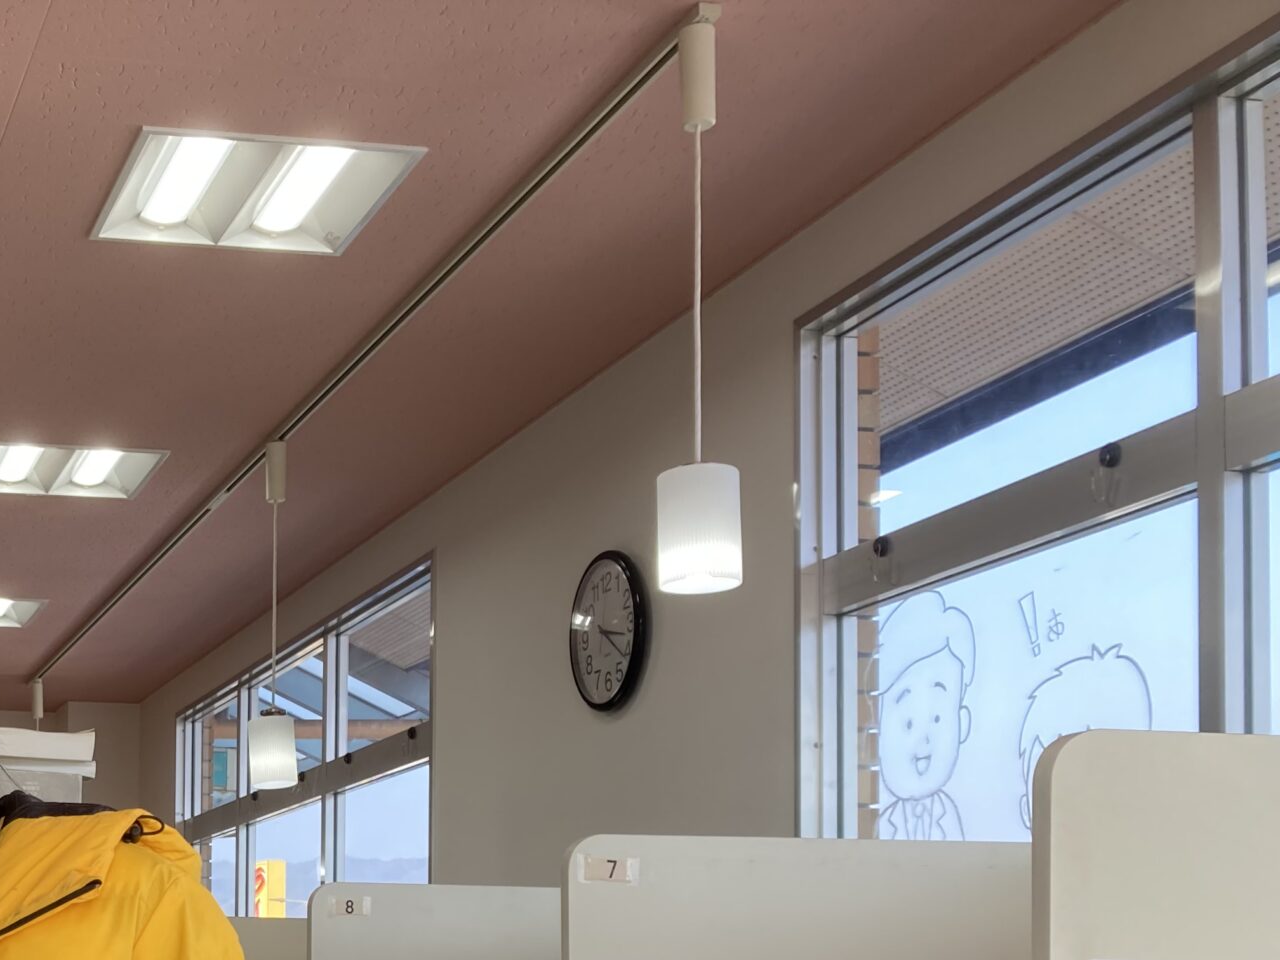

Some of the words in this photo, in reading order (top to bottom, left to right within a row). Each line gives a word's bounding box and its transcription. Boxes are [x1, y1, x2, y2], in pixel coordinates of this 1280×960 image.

[592, 582, 600, 603] 11
[600, 571, 612, 595] 12
[615, 574, 621, 593] 1
[623, 589, 631, 611] 2
[626, 610, 633, 634] 3
[581, 631, 590, 651] 9
[585, 655, 593, 675] 8
[616, 661, 624, 683] 5
[594, 669, 602, 691] 7
[604, 671, 613, 692] 6
[606, 859, 618, 879] 7
[345, 899, 355, 914] 8
